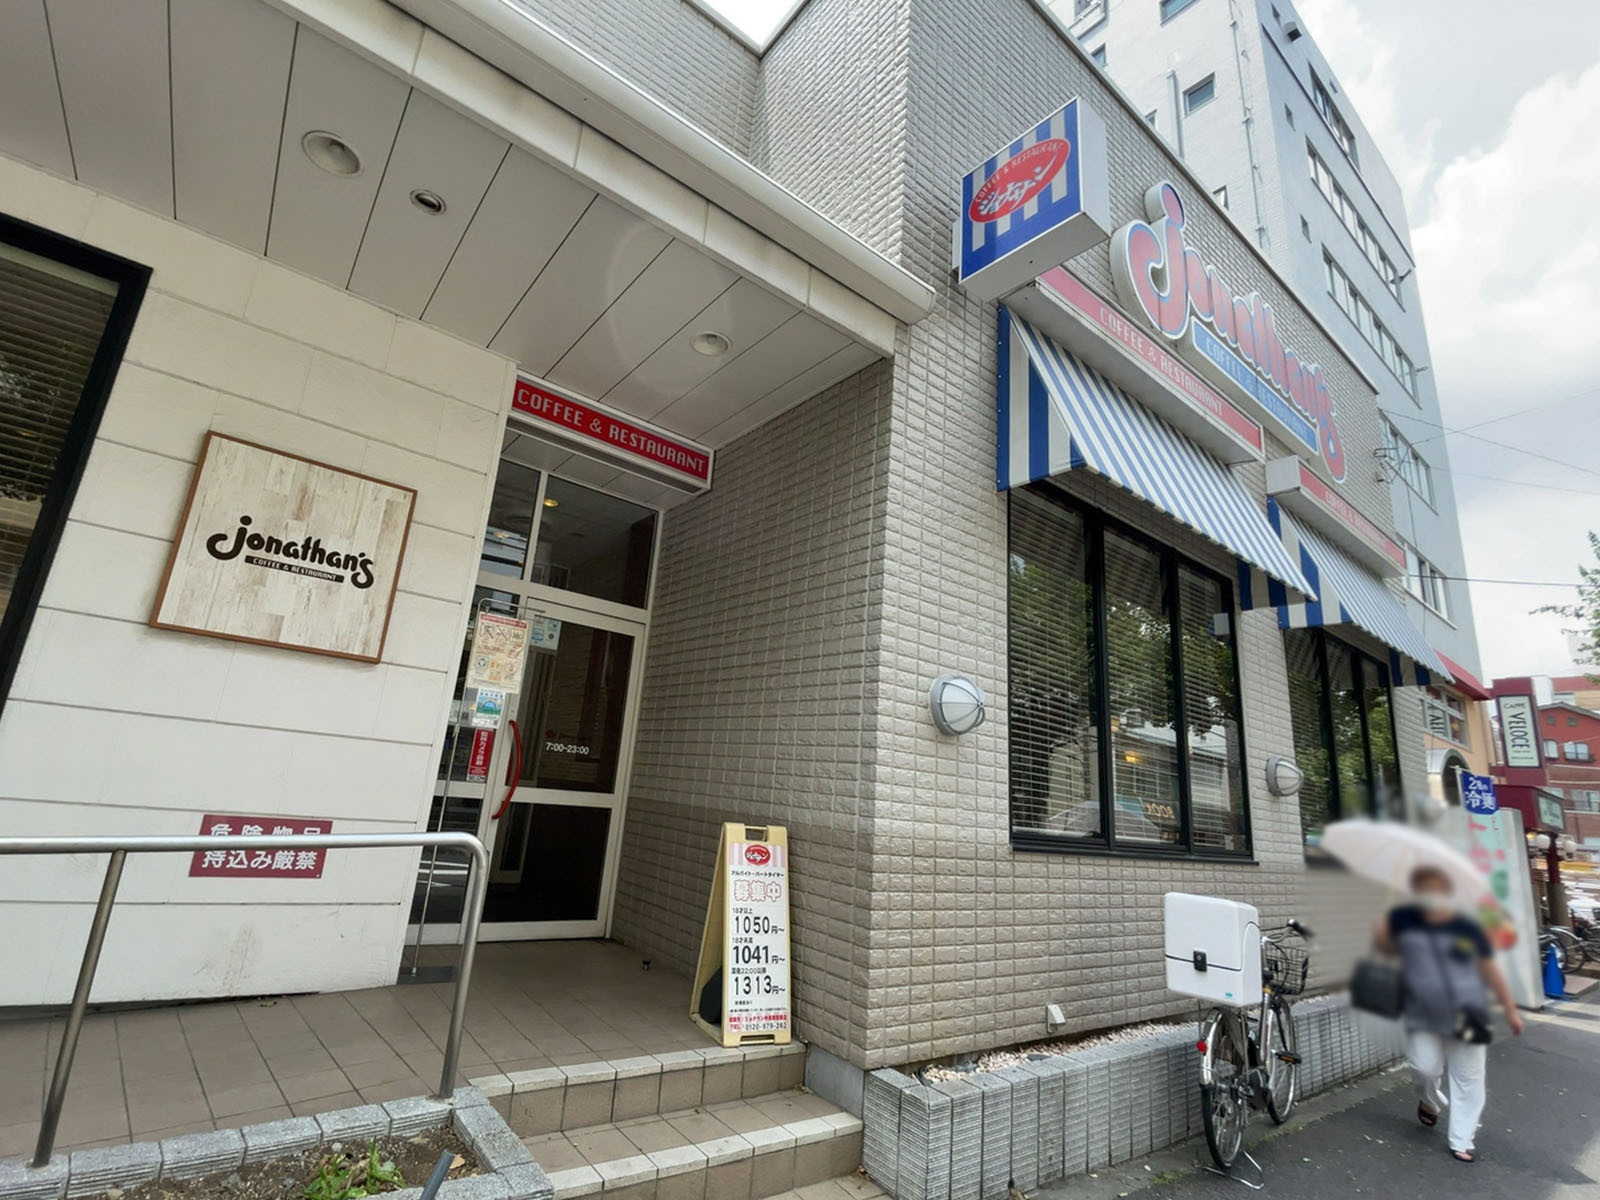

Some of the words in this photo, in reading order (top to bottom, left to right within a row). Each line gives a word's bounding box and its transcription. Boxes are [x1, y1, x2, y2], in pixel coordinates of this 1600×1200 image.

[1100, 306, 1144, 355] COFFEE
[1147, 346, 1157, 363] &
[1160, 354, 1222, 417] RESTAURANT
[517, 388, 584, 427] COFFEE
[589, 418, 602, 434] &
[608, 424, 706, 473] RESTAURANT
[253, 557, 281, 570] COFFEE
[291, 566, 337, 581] RESTAURANT
[1508, 711, 1531, 750] VELOCE
[201, 850, 318, 870] 持込み厳禁
[733, 880, 782, 903] 募集中
